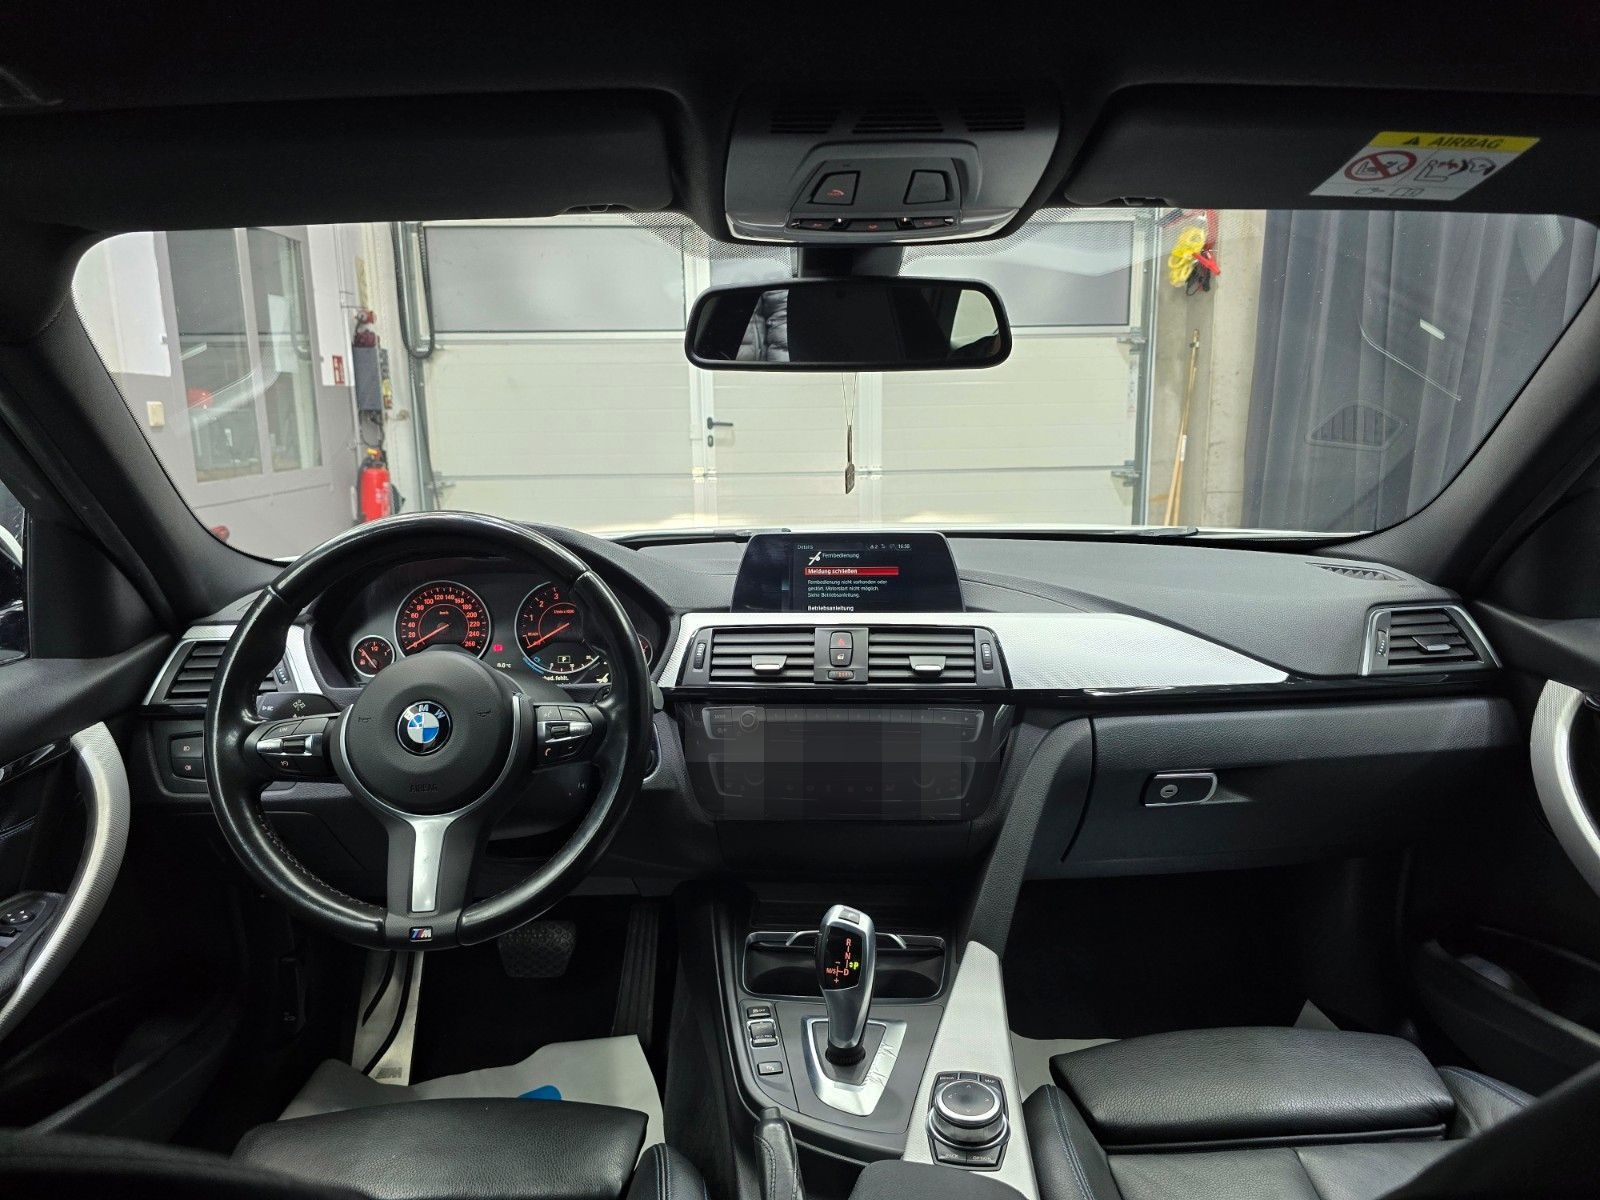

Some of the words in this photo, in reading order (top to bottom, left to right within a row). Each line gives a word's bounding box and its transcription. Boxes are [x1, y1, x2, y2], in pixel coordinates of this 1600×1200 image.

[1427, 136, 1504, 149] AIRBAG
[404, 703, 446, 721] BMW
[409, 783, 438, 793] AIRBAG
[846, 938, 851, 946] R
[845, 952, 851, 960] N
[843, 968, 849, 976] D
